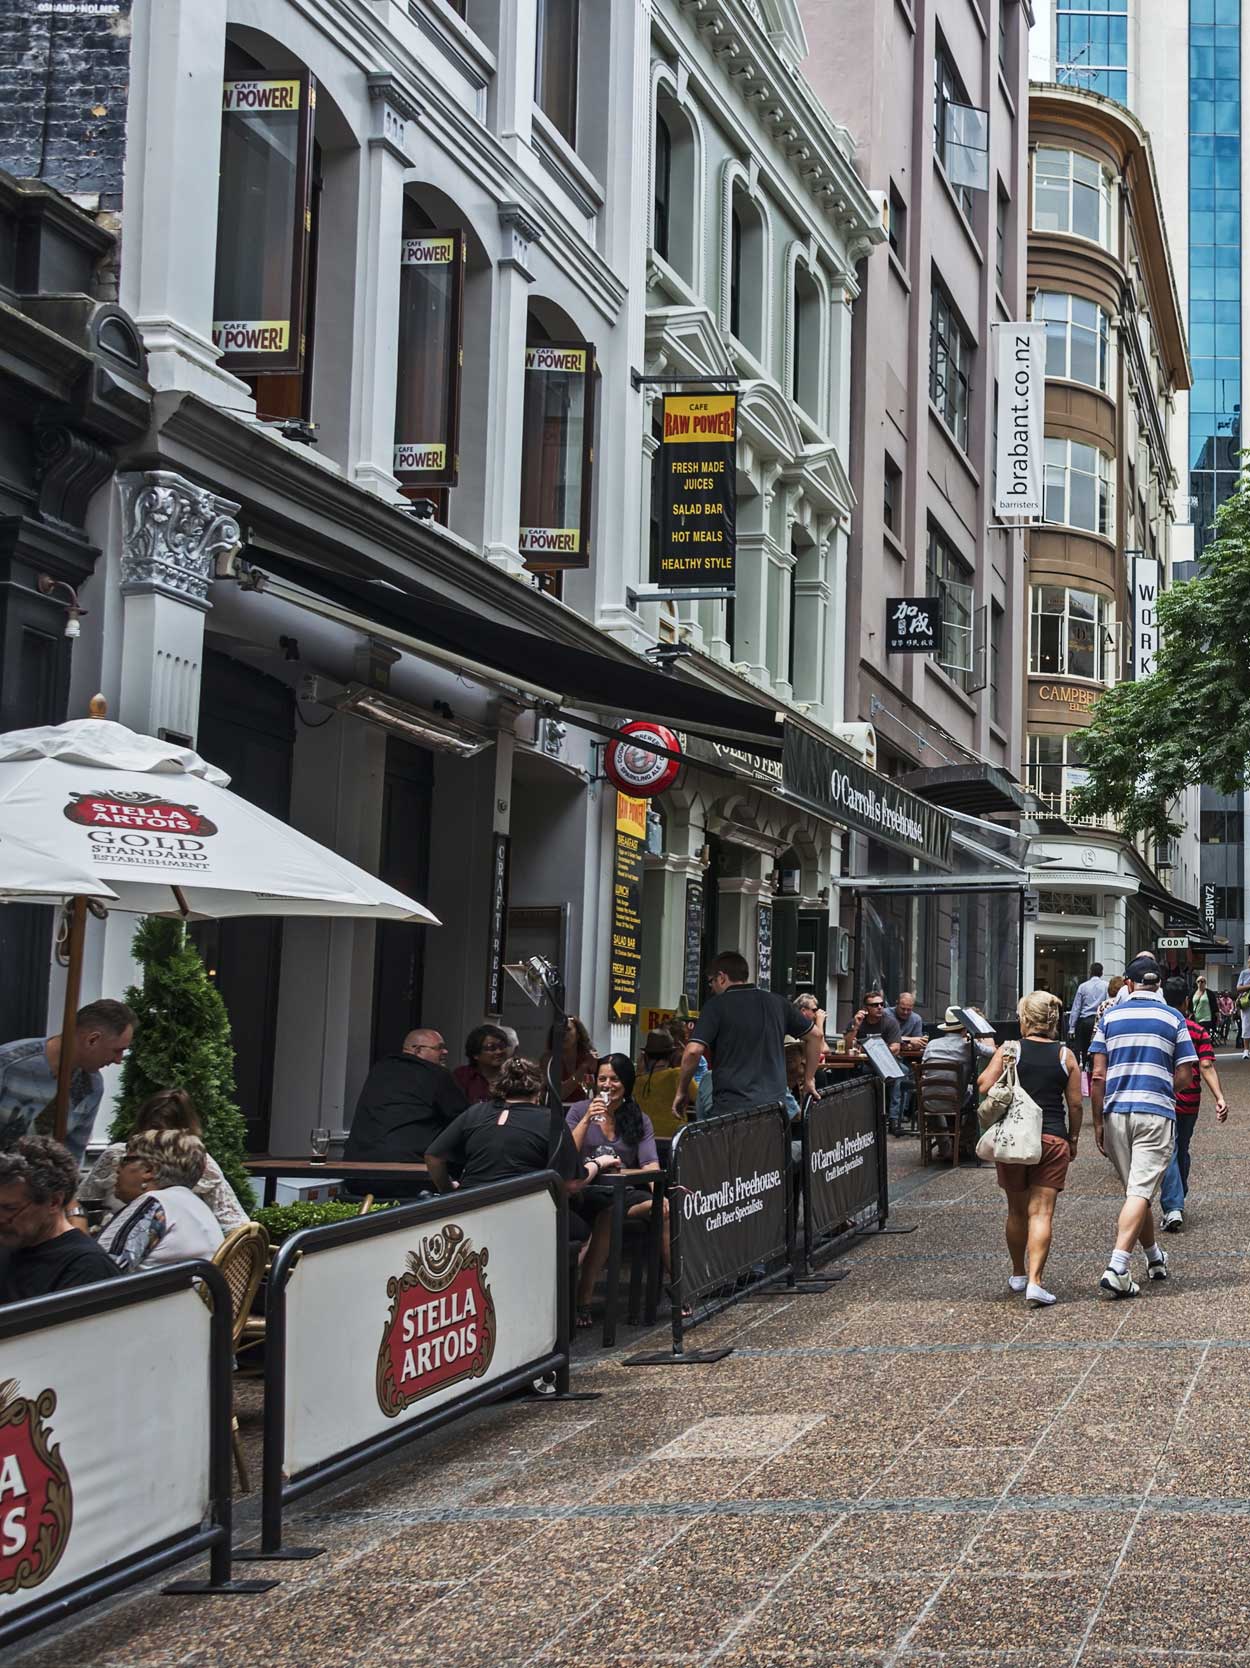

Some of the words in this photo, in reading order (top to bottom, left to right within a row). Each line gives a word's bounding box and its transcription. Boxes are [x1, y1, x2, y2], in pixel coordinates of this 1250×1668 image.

[236, 86, 294, 108] POWER!
[407, 245, 451, 262] POWER!
[223, 323, 248, 331] CAFE
[224, 327, 283, 350] POWER!
[537, 354, 582, 371] POWER!
[689, 403, 708, 411] CAFE
[1006, 335, 1031, 496] brabant.co.nz
[664, 411, 690, 438] RAW
[692, 407, 735, 438] POWER!
[399, 451, 442, 468] POWER!
[671, 461, 699, 474] FRESH
[701, 461, 725, 473] MADE
[683, 478, 714, 491] JUICES
[672, 503, 702, 516] SALAD
[704, 503, 723, 515] BAR
[999, 500, 1040, 510] barristers
[530, 533, 575, 550] POWER!
[671, 531, 690, 542] HOT
[693, 530, 723, 542] MEALS
[661, 558, 702, 570] HEALTHY
[704, 557, 732, 569] STYLE
[1139, 583, 1154, 674] WORK
[91, 802, 187, 821] STELLA
[831, 768, 881, 825] O'Carroll's
[881, 794, 924, 844] Freehouse.
[93, 812, 192, 831] ARTOIS
[87, 830, 205, 852] GOLD
[91, 844, 208, 862] STANDARD
[92, 853, 210, 871] ESTABLISHMENT
[1161, 939, 1185, 947] CODY
[811, 1140, 844, 1173] O'Carroll's
[825, 1169, 836, 1182] Craft
[836, 1166, 845, 1177] Beer
[683, 1181, 734, 1221] O'Carroll's
[735, 1170, 781, 1201] Freehouse.
[706, 1214, 722, 1232] Craft
[722, 1210, 735, 1225] Beer
[735, 1198, 764, 1222] Specialists
[402, 1287, 478, 1343] STELLA
[400, 1322, 478, 1384] ARTOIS
